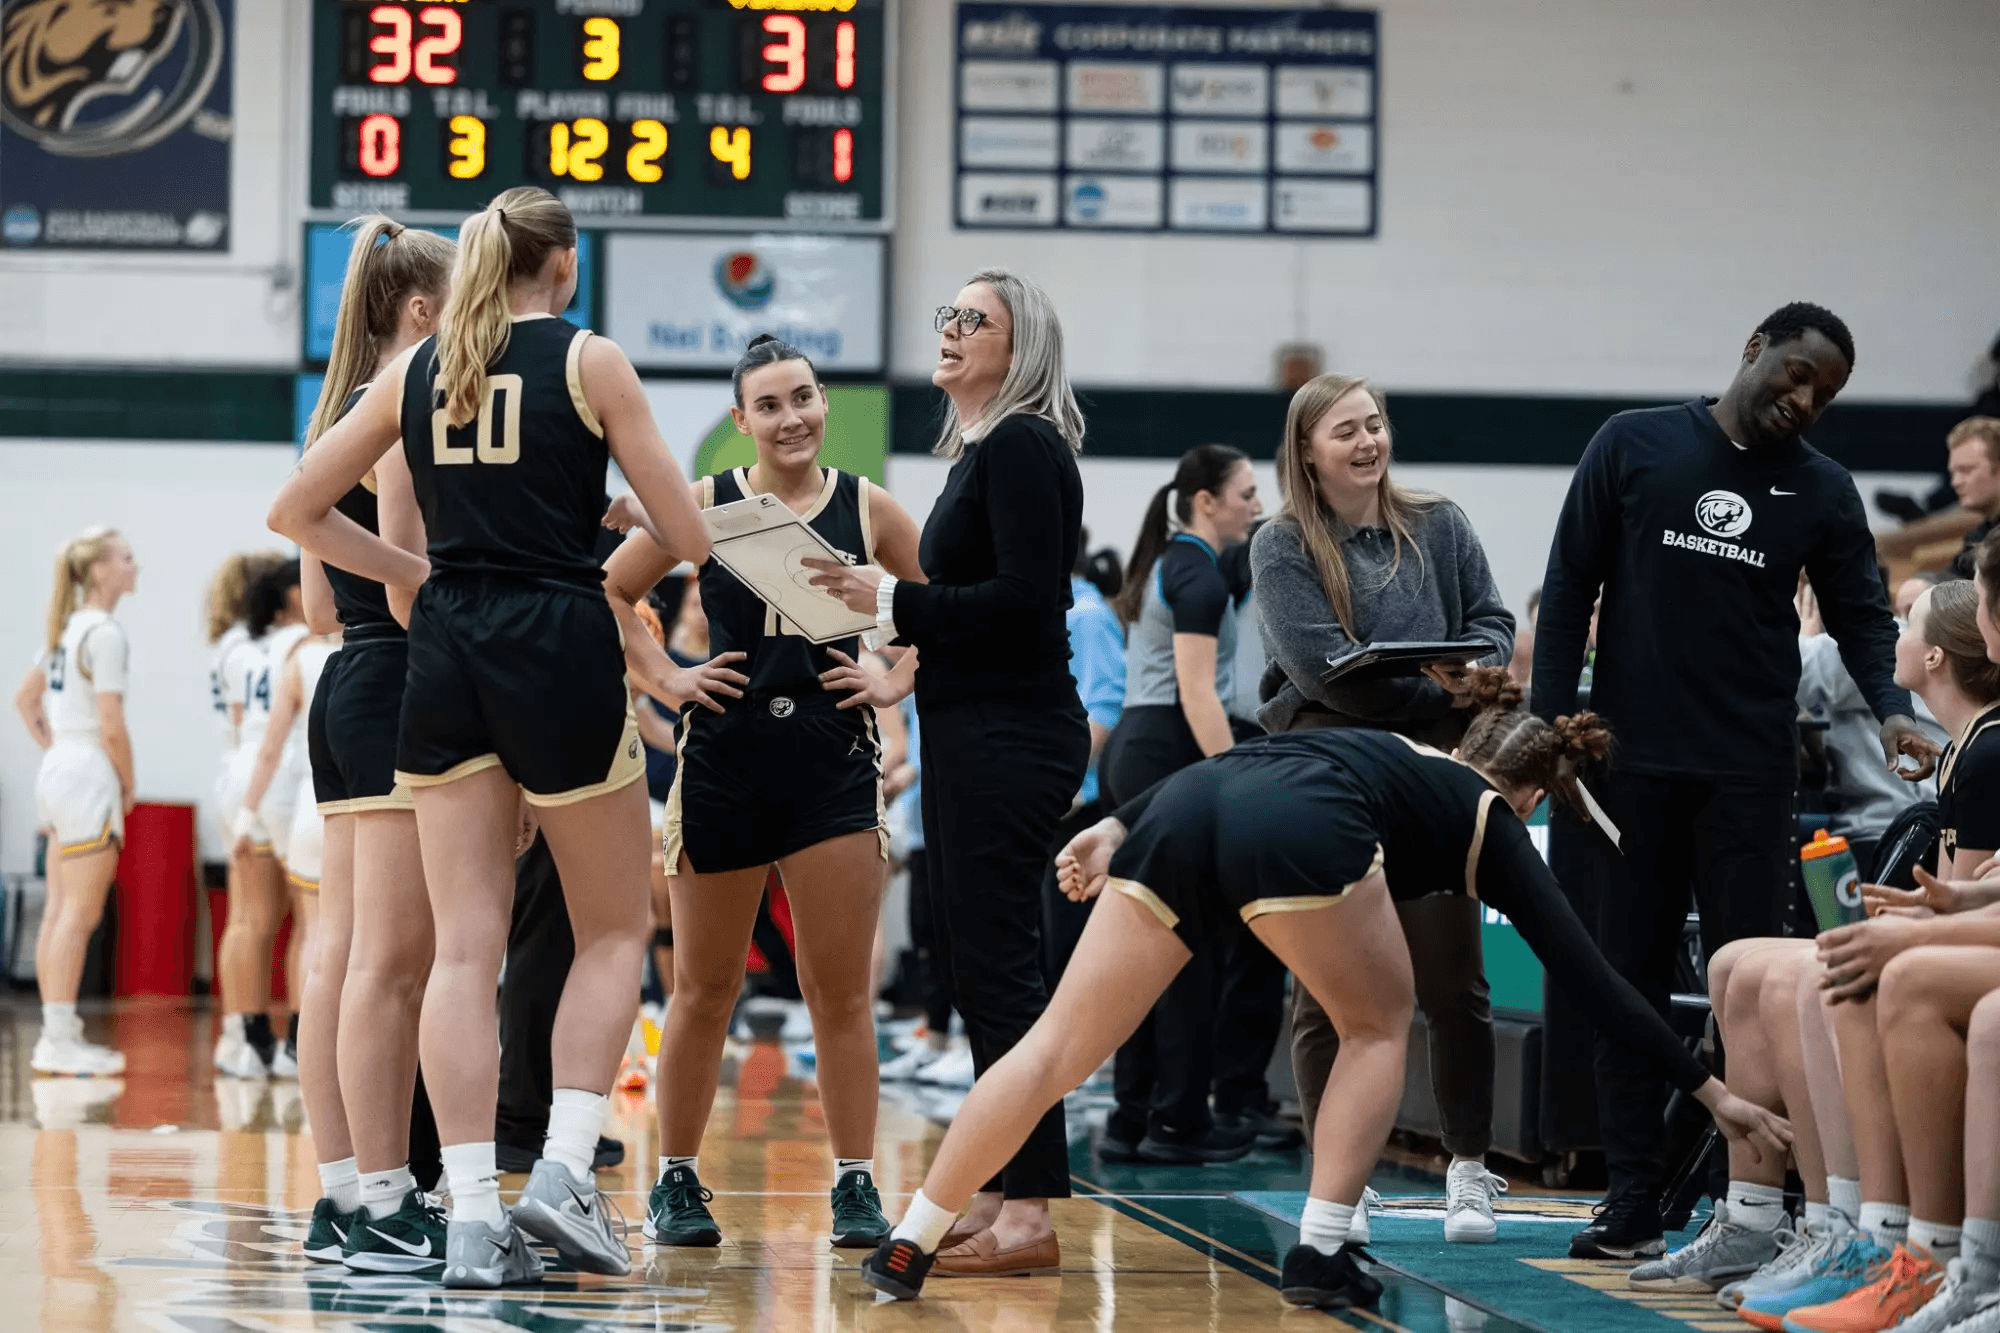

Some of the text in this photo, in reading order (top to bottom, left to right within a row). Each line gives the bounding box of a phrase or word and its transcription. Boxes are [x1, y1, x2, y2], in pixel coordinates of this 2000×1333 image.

[368, 5, 462, 84] 32
[583, 16, 620, 81] 3
[761, 13, 856, 93] 31
[359, 113, 400, 177] 0
[449, 115, 487, 179] 3
[550, 118, 609, 181] 12
[626, 119, 668, 183] 2
[710, 126, 751, 180] 4
[832, 127, 853, 182] 1
[432, 373, 523, 465] 20
[1662, 529, 1765, 568] BASKETBALL
[243, 666, 270, 712] 14
